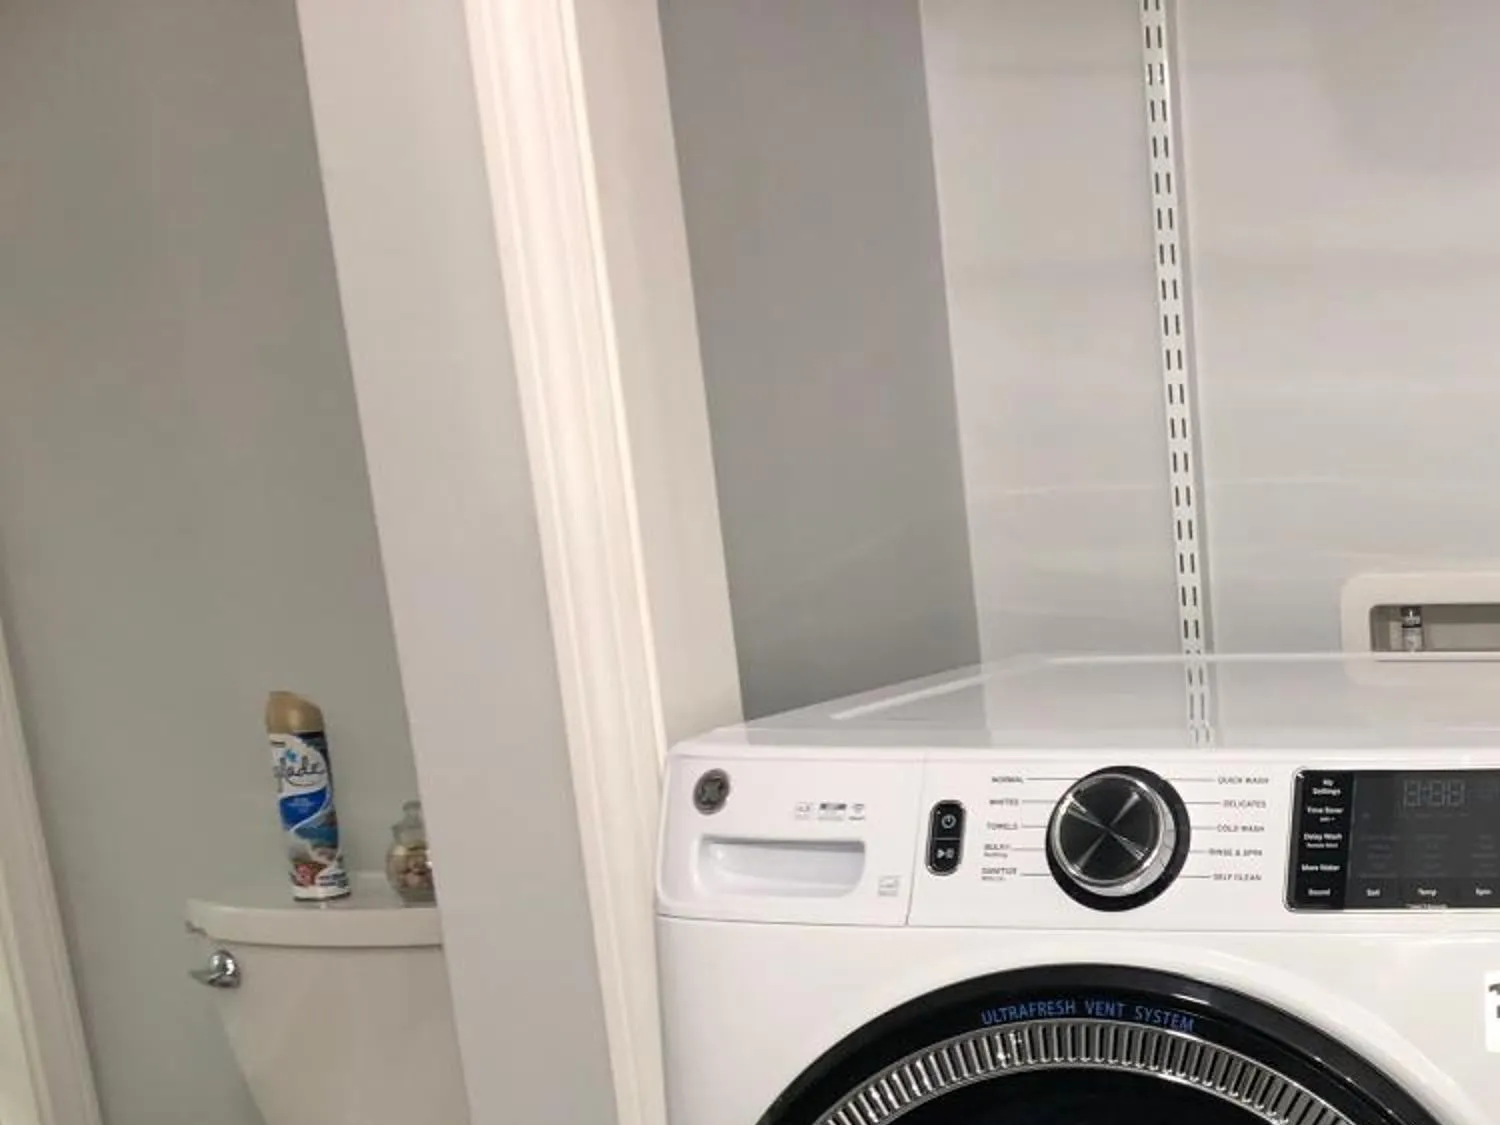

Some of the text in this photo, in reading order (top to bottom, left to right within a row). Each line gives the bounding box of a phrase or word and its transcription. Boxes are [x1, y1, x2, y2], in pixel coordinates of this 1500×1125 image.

[1217, 777, 1244, 785] QUICK
[1223, 800, 1267, 808] DELICATES
[1216, 824, 1265, 832] COLD WASH
[1212, 873, 1262, 881] SELF CLEAN
[981, 1000, 1194, 1033] ULTRAFRESH VENT SYSTEM
